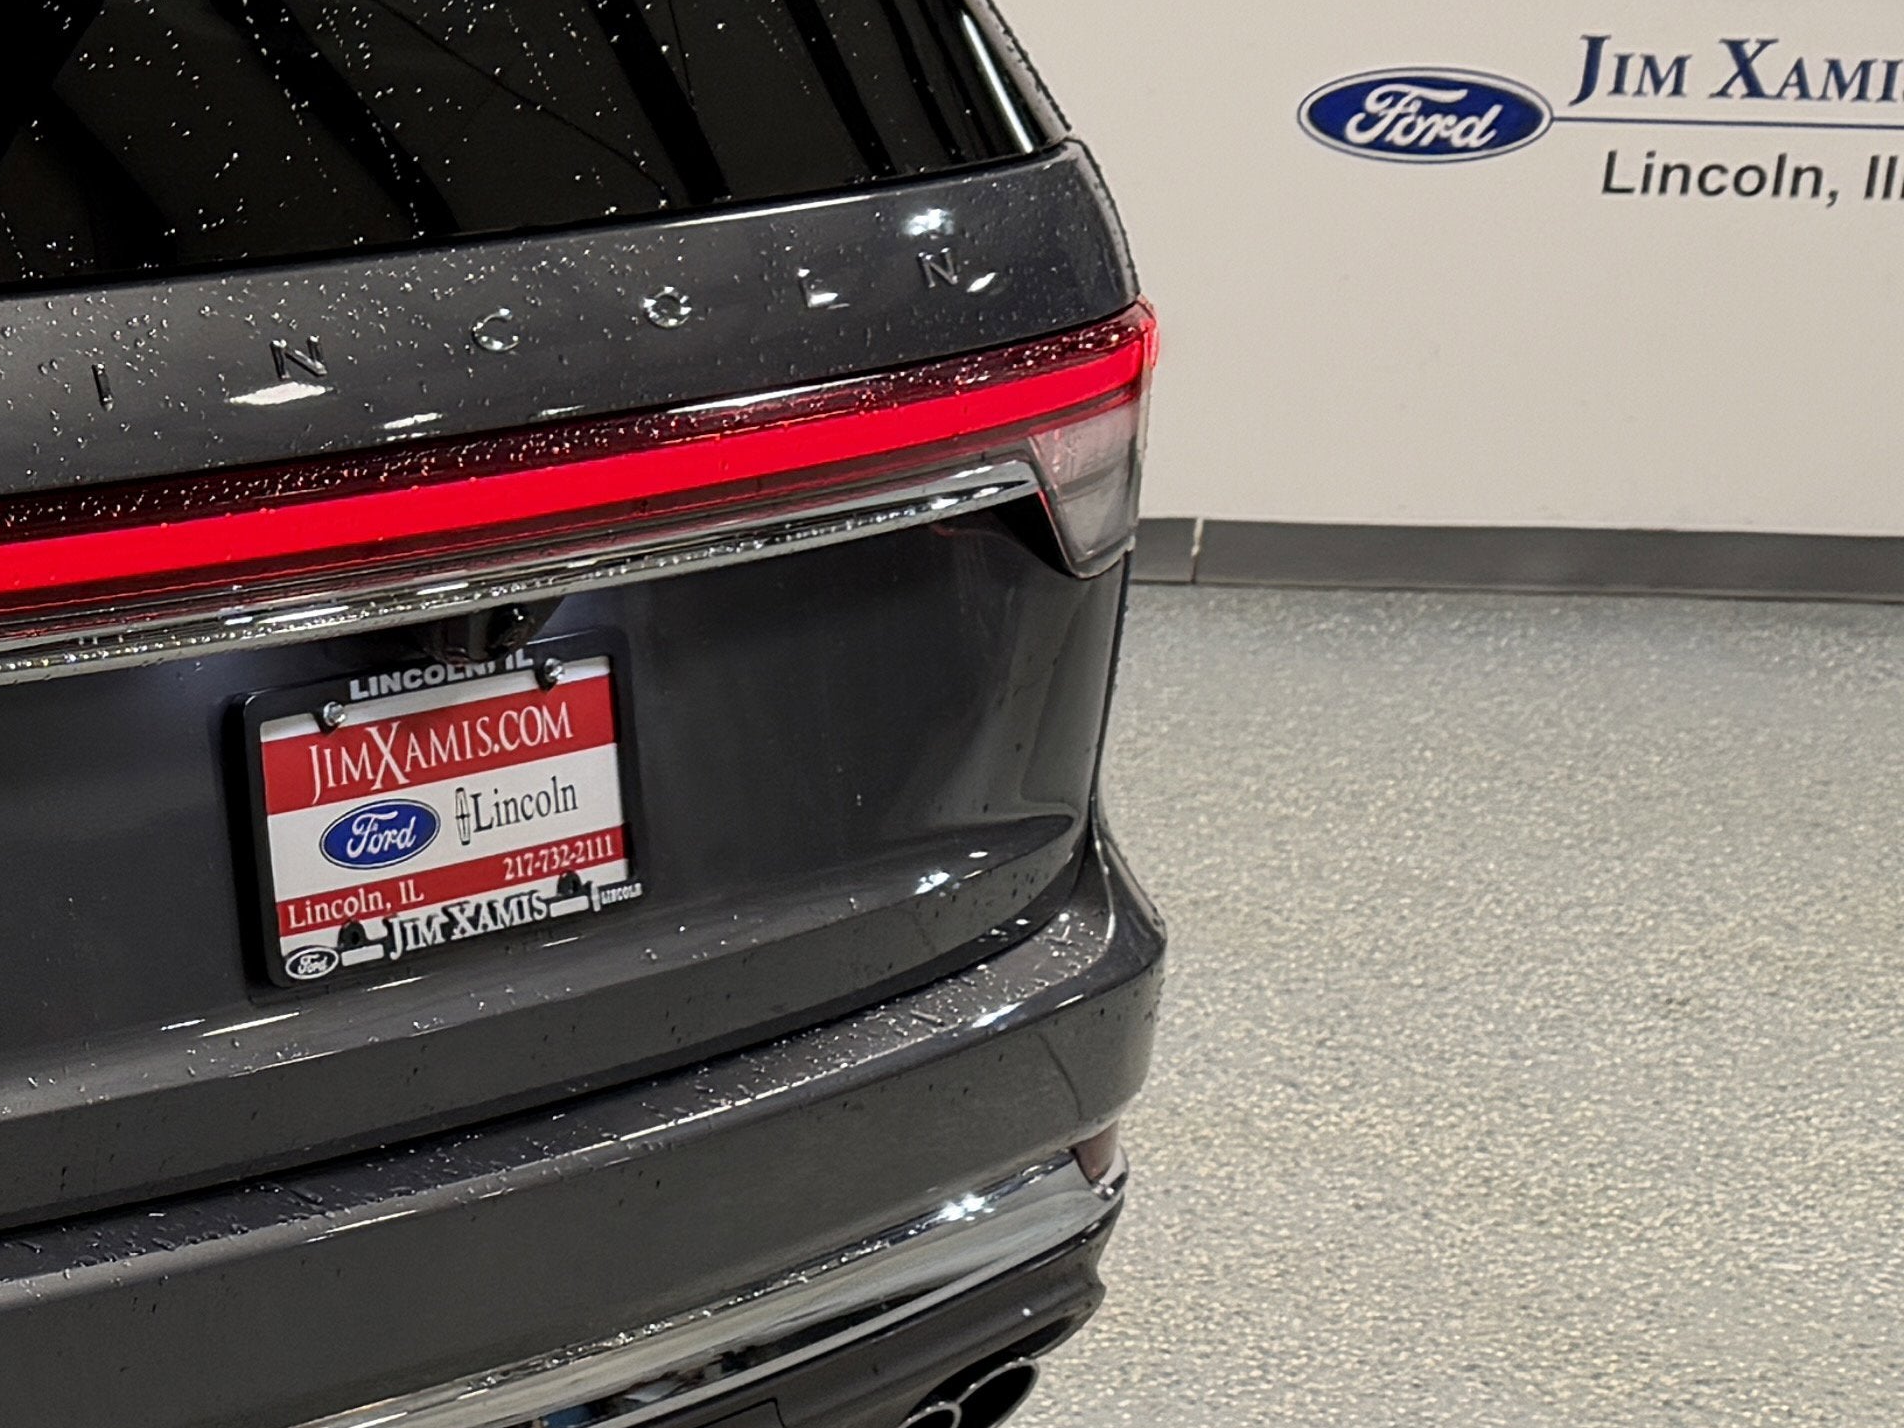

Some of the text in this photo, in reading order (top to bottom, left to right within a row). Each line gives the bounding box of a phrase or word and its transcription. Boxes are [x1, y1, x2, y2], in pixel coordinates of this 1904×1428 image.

[1568, 34, 1904, 107] JIM XAMI
[1344, 82, 1504, 149] Ford
[1601, 149, 1840, 209] Lincoln,
[506, 648, 534, 670] IL
[471, 775, 579, 834] Lincoln
[345, 809, 417, 859] Ford
[503, 834, 614, 882] 217-732-2111
[287, 880, 425, 930] Lincoln, IL
[389, 893, 549, 960] JIM XAMIS
[296, 952, 329, 974] Ford
